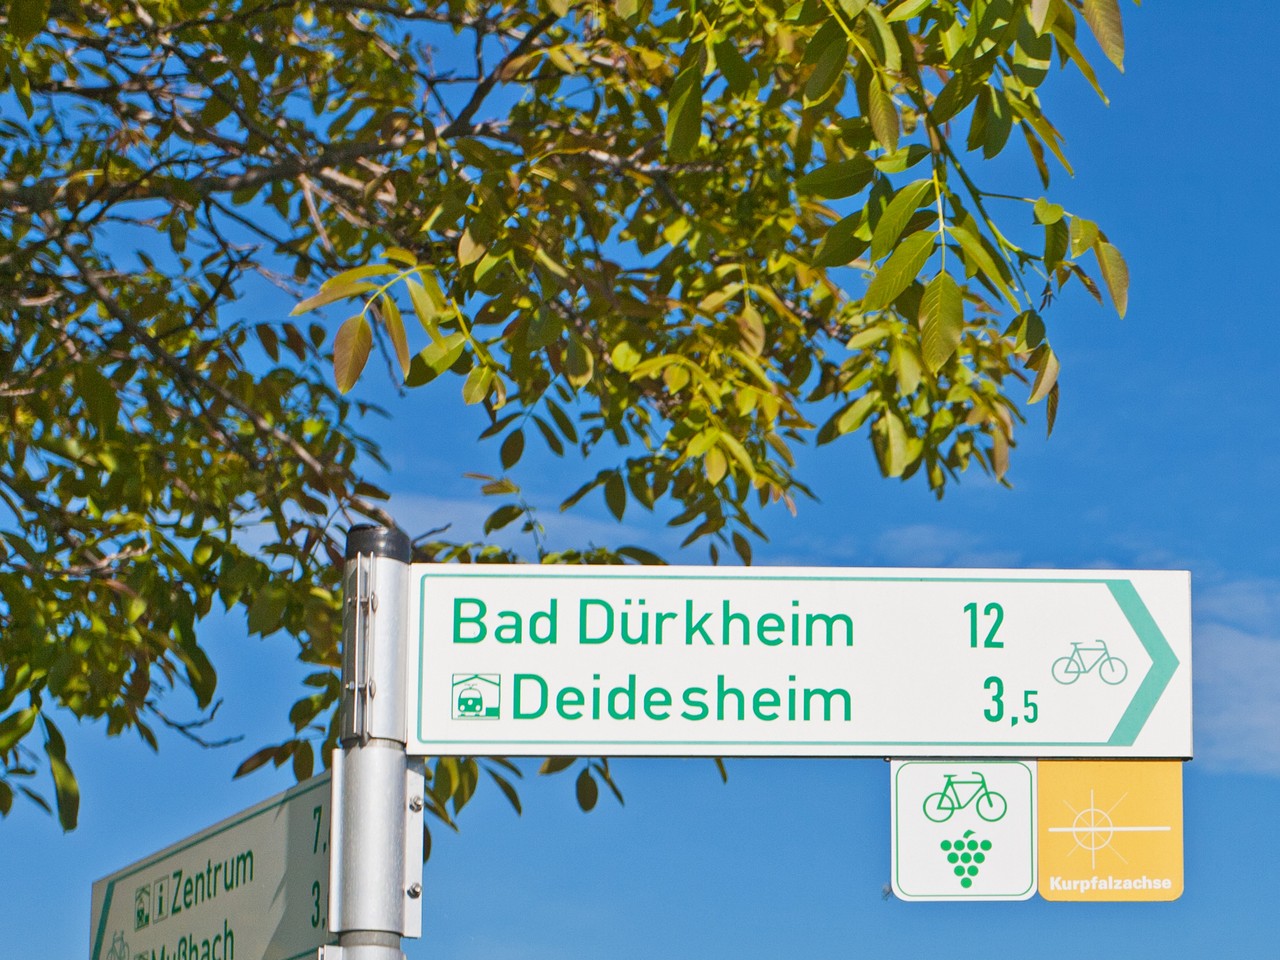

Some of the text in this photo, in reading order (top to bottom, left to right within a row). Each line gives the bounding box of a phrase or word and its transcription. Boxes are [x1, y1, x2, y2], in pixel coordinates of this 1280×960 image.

[453, 597, 1005, 648] Bad Dürkheim 12
[512, 673, 1039, 727] Deidesheim 3,5
[171, 849, 254, 917] Zentrum
[1049, 875, 1172, 894] Kurpfalzachse
